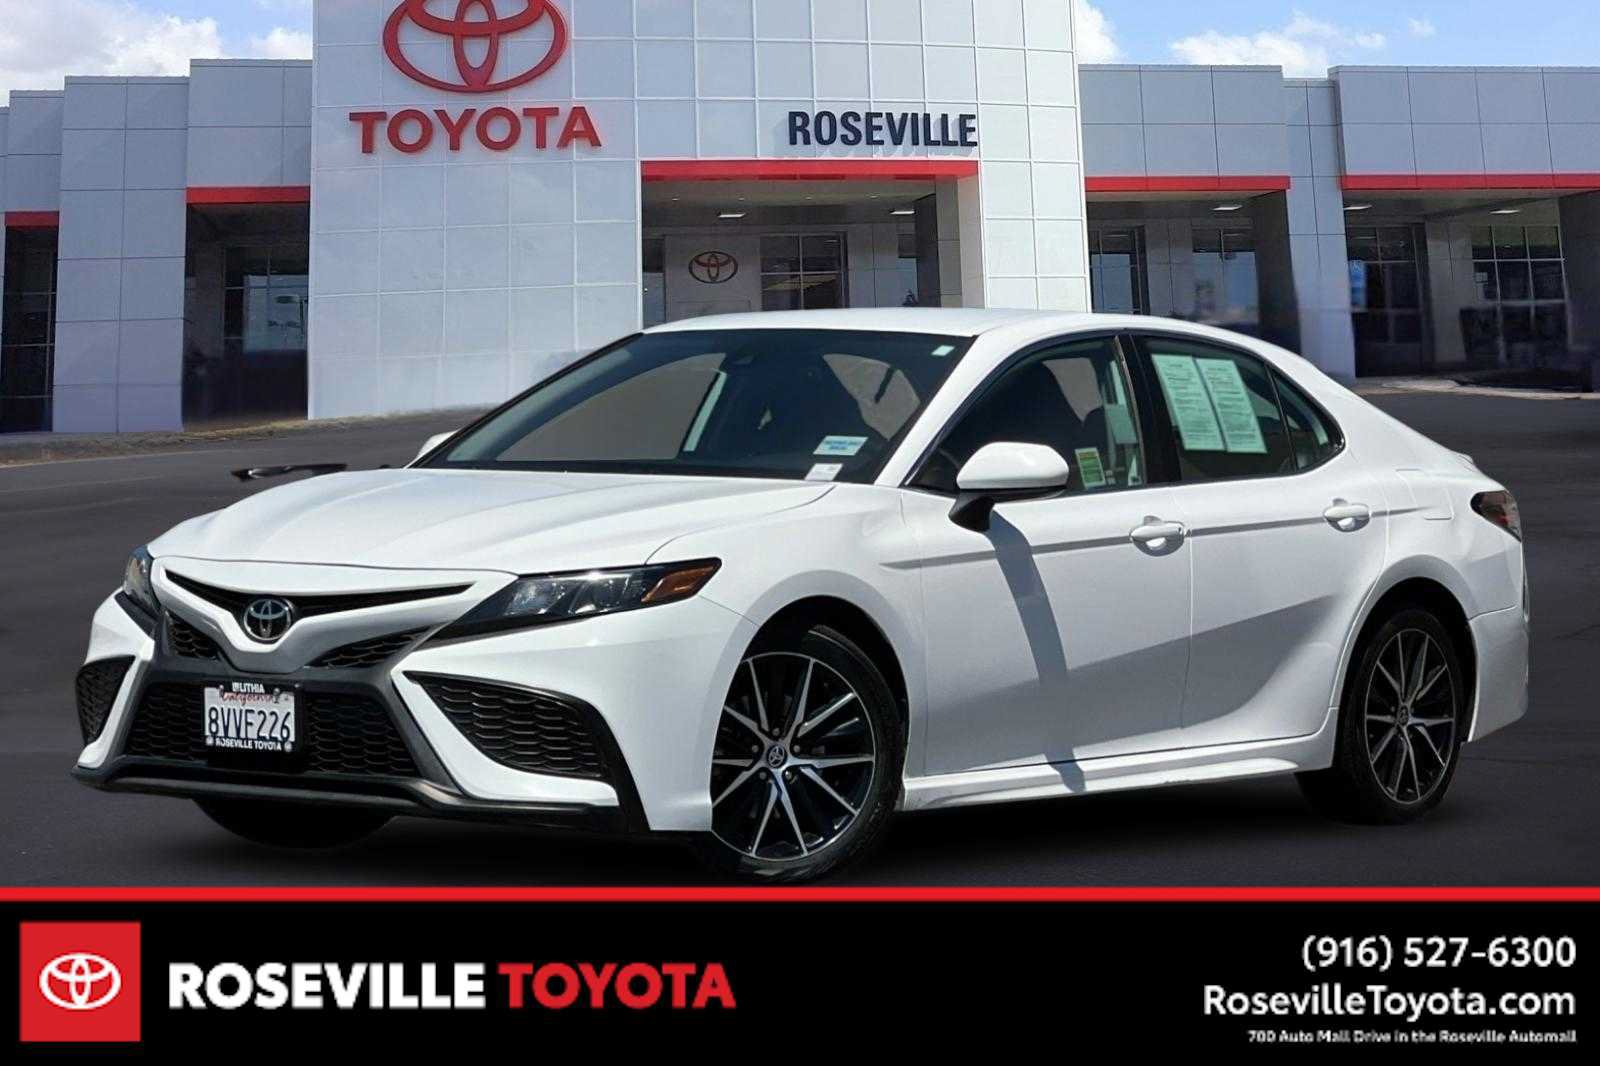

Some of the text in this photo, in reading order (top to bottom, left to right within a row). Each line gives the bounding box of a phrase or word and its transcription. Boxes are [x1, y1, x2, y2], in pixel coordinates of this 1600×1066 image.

[349, 106, 602, 153] TOYOTA
[789, 111, 978, 147] ROSEVILLE
[240, 682, 265, 693] LITHIA
[208, 706, 291, 742] 8VVF226
[215, 737, 282, 751] ROSEVILLE TOYOTA
